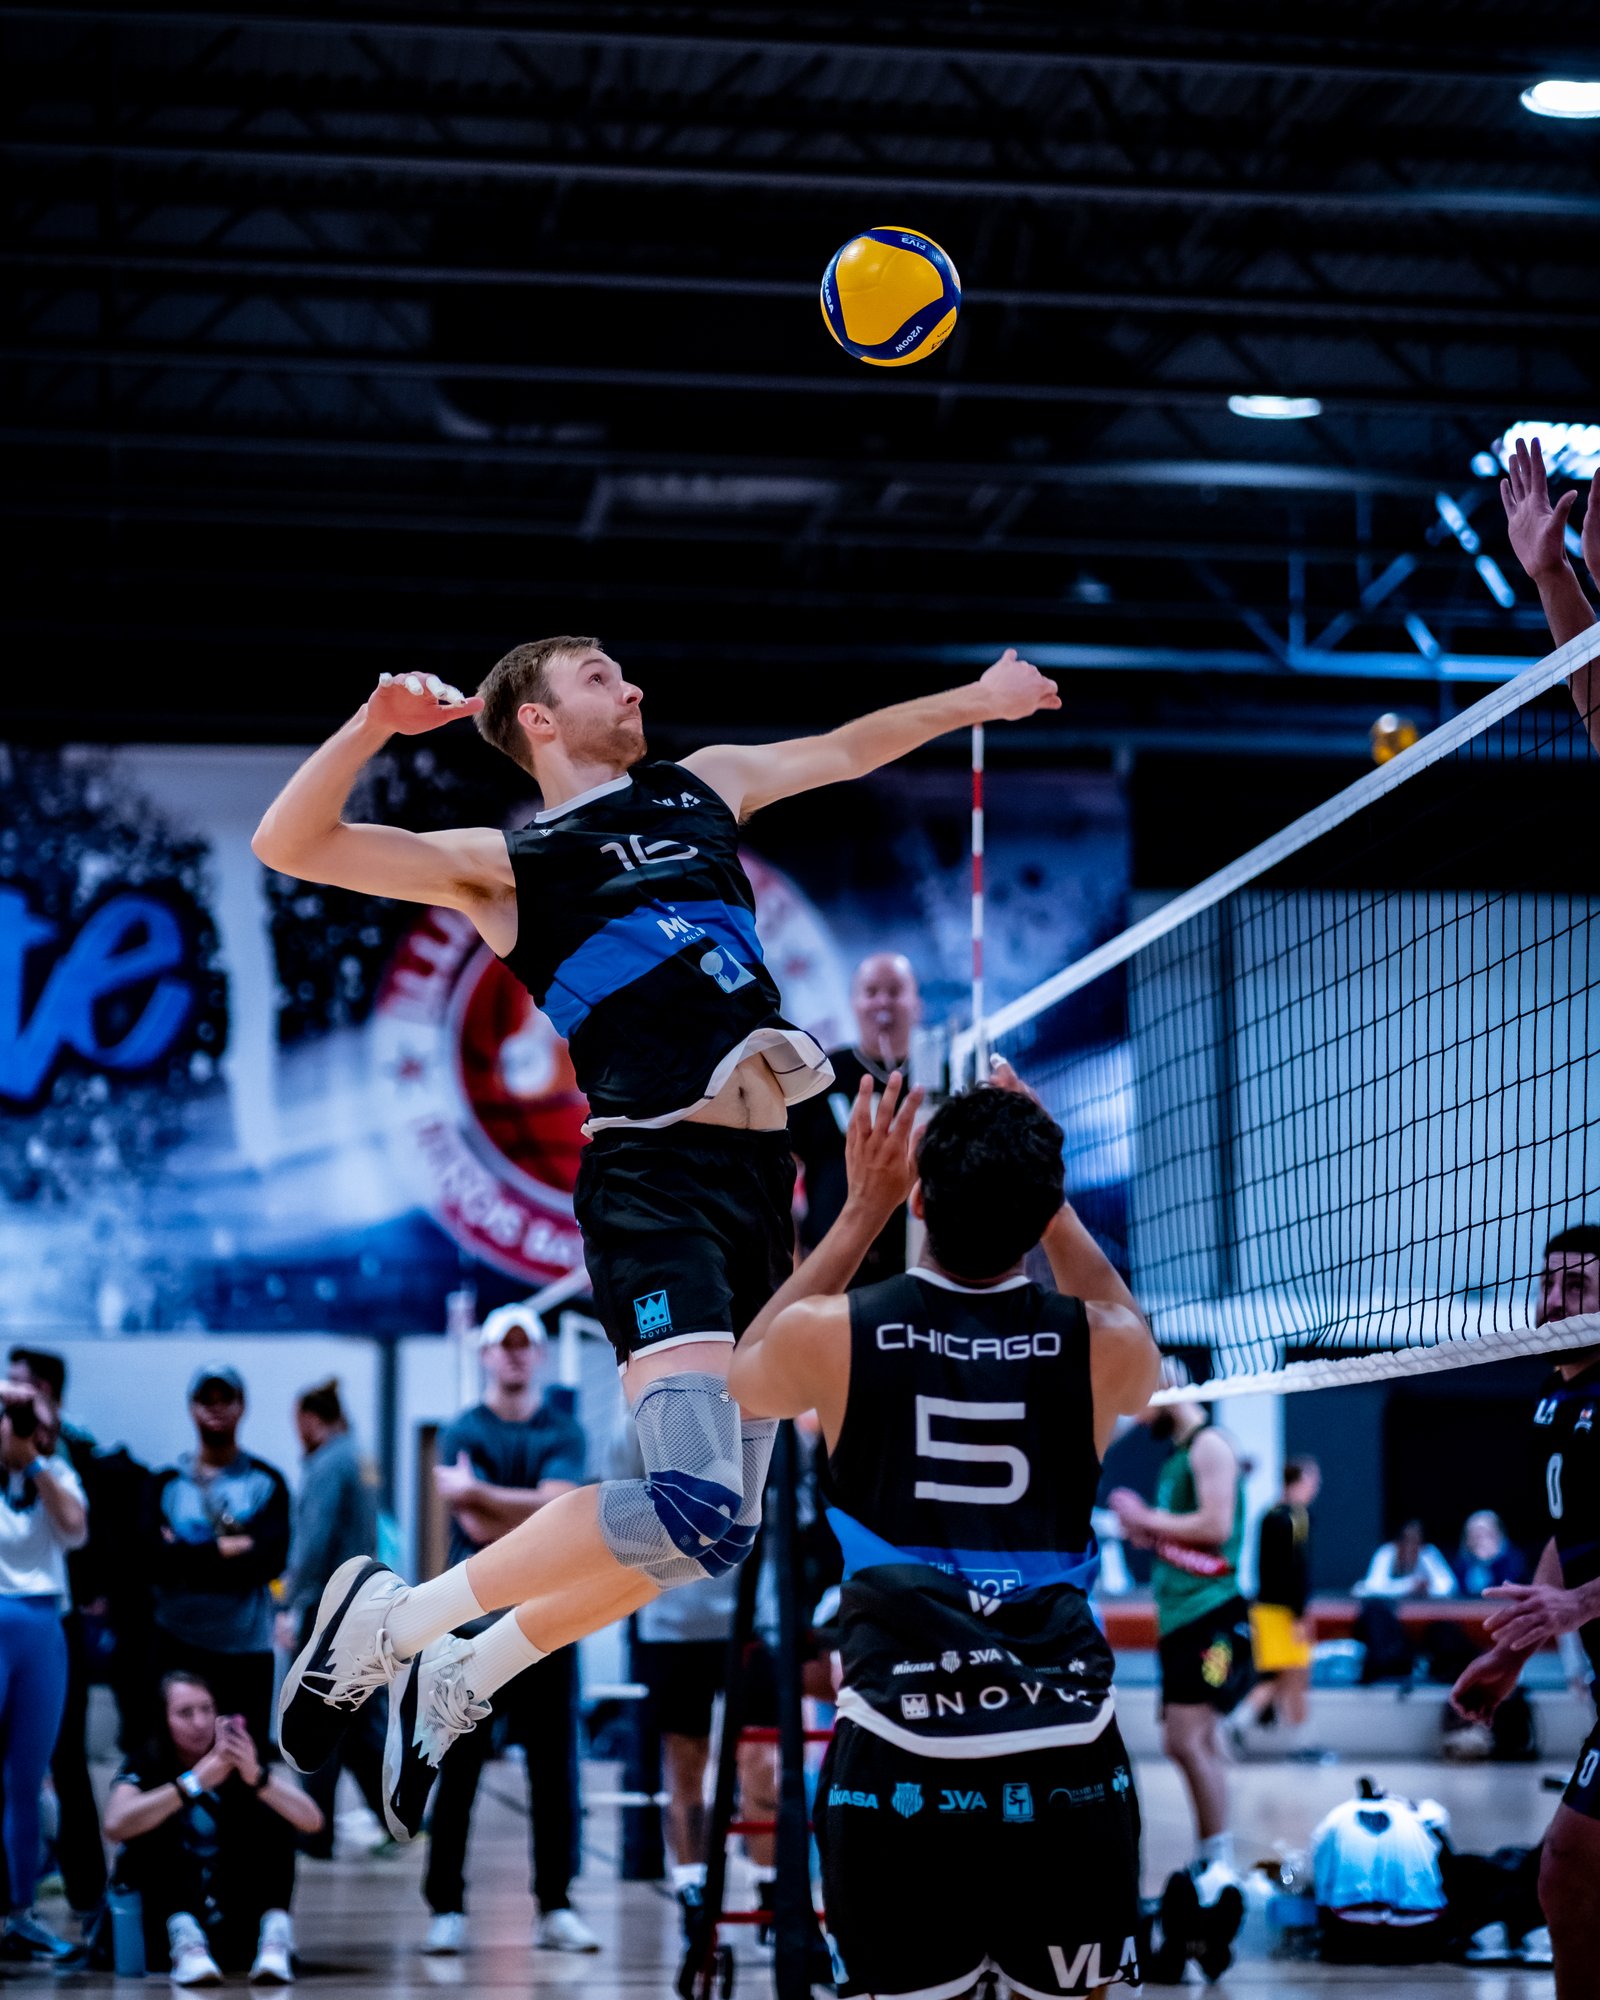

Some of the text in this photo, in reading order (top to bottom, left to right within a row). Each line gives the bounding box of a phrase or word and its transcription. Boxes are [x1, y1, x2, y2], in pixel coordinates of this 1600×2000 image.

[895, 325, 924, 353] V200W
[600, 833, 699, 872] 16
[640, 1325, 674, 1340] NOVUS
[876, 1323, 1061, 1361] CHICAGO
[915, 1394, 1031, 1505] 5
[1546, 1452, 1564, 1520] 0
[968, 1647, 1004, 1666] JVA
[938, 1789, 988, 1811] JVA
[1047, 1935, 1142, 1989] VLA
